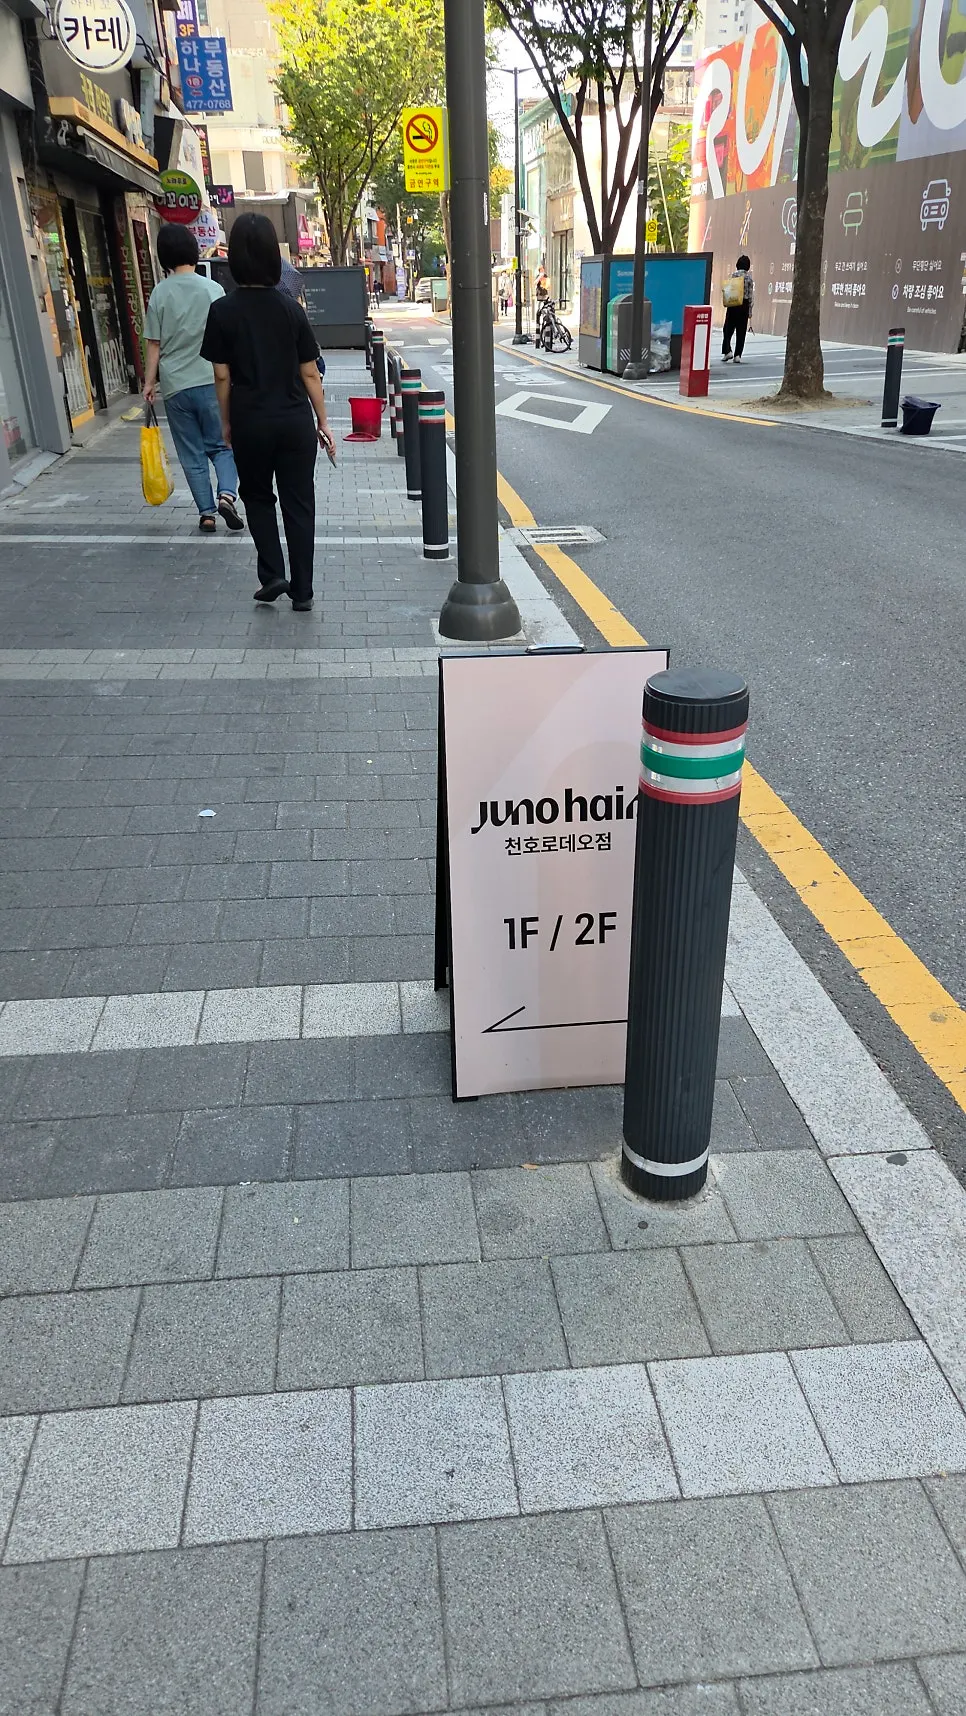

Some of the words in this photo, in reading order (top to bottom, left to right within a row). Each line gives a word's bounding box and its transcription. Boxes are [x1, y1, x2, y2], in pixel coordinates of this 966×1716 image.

[63, 15, 123, 52] 카레
[179, 23, 195, 37] 3F
[180, 40, 202, 73] 하나
[204, 40, 226, 97] 부동산
[186, 99, 231, 110] 477-0768
[410, 178, 439, 188] 금연구역
[902, 284, 915, 299] 차량
[914, 284, 926, 299] 조심
[926, 284, 944, 300] 좋아요
[471, 797, 559, 834] juno
[504, 832, 612, 856] 천호로데오점
[503, 916, 540, 949] 1F
[549, 915, 563, 951] /
[575, 912, 617, 946] 2F
